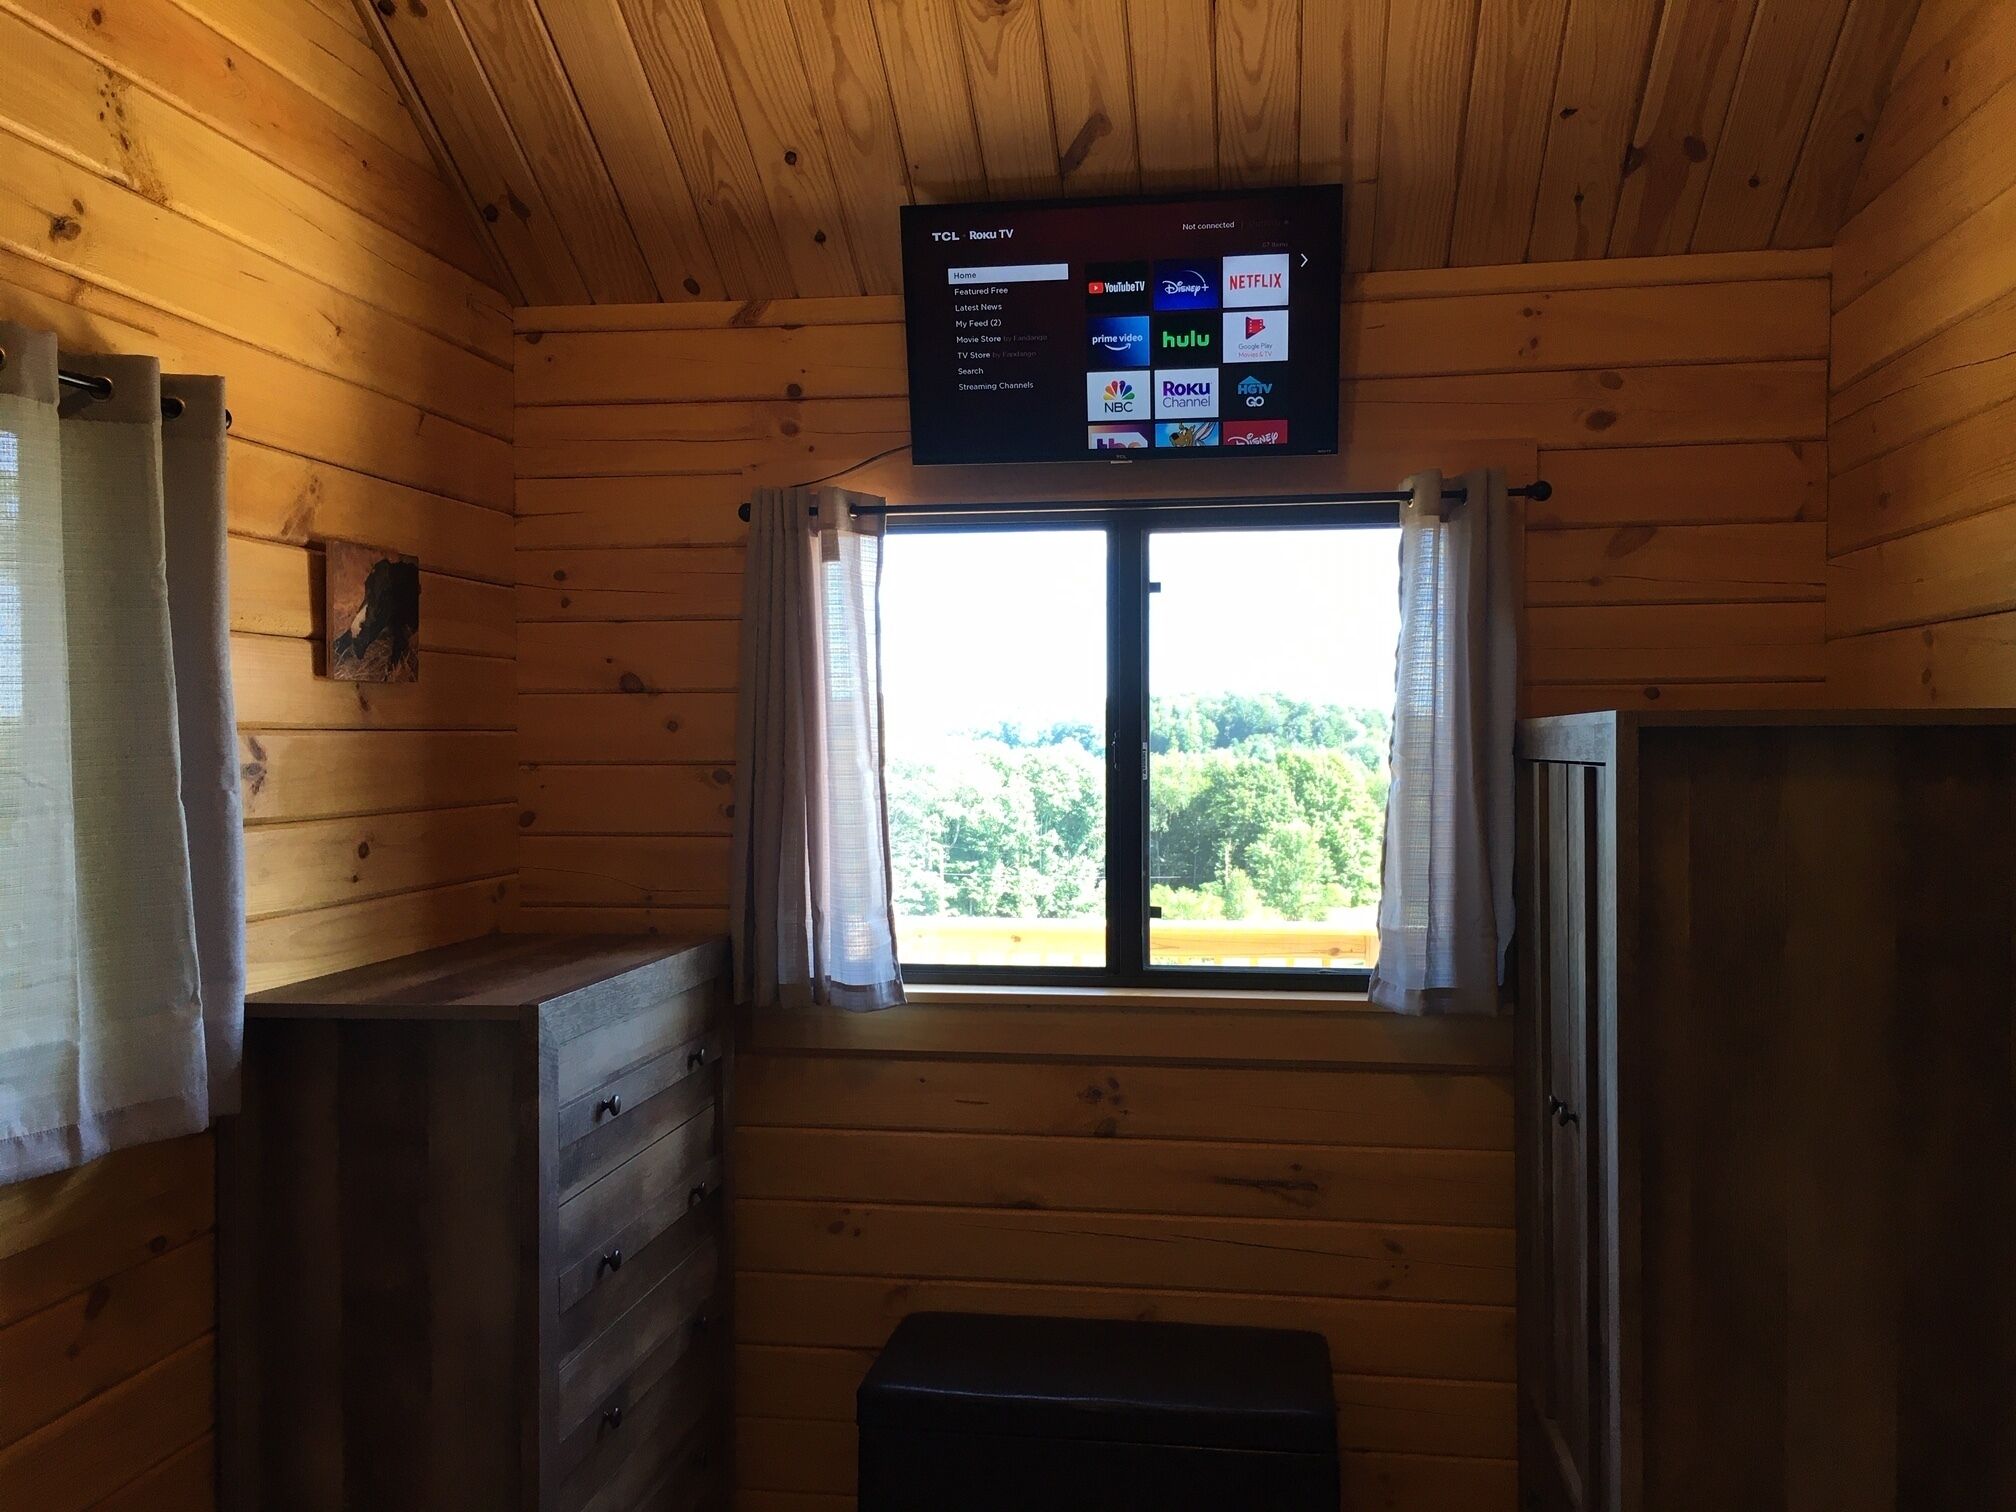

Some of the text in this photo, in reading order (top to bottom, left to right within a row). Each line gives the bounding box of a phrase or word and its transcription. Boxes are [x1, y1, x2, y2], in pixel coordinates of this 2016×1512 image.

[1182, 223, 1196, 231] Not
[1197, 221, 1235, 230] connected
[932, 229, 1014, 242] TCL Roku TV
[953, 271, 977, 280] Home
[1229, 273, 1282, 290] NETFLIX
[954, 286, 1009, 296] Featured Free
[954, 303, 1003, 312] Latest News
[955, 318, 1002, 329] My Feed (2)
[956, 335, 979, 344] Movie
[980, 335, 1002, 343] Store
[1092, 333, 1143, 346] prime video
[1162, 330, 1210, 348] hulu
[1238, 342, 1273, 351] Google Play
[957, 351, 969, 359] TV
[970, 351, 991, 359] Store
[957, 367, 984, 376] Search
[958, 381, 1034, 392] Streaming Channels
[1162, 381, 1211, 396] Roku
[1237, 382, 1273, 395] HGTV
[1104, 401, 1134, 413] NBC
[1162, 396, 1211, 408] Channel
[1245, 396, 1265, 408] GO
